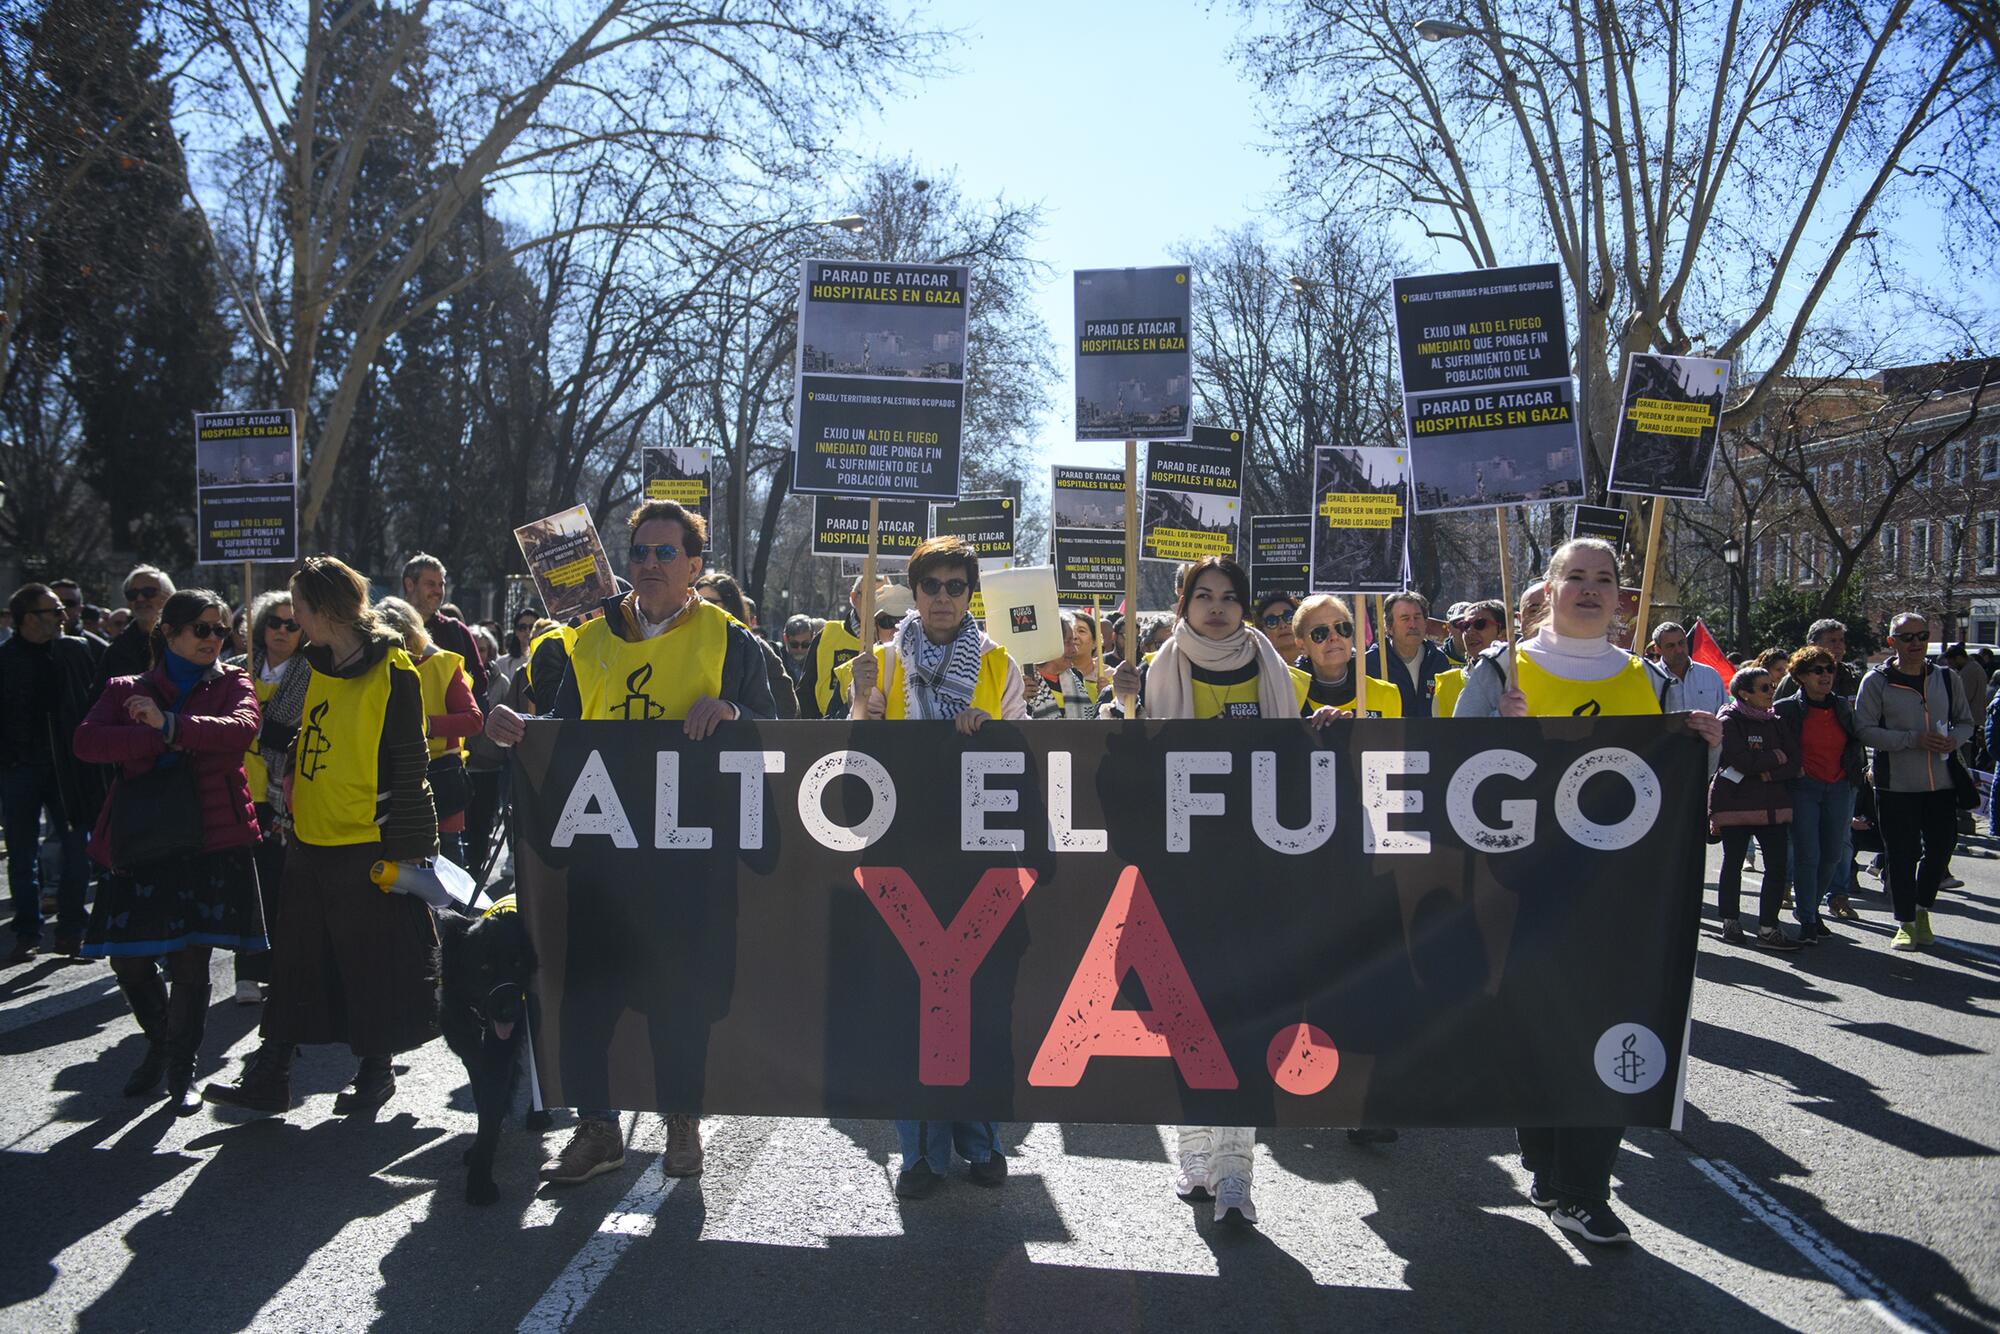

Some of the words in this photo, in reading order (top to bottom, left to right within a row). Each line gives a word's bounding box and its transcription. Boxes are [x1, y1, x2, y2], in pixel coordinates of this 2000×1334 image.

[822, 269, 868, 283] PARAD
[873, 272, 891, 284] DE
[896, 273, 949, 286] ATACAR
[813, 285, 897, 301] HOSPITALES
[902, 289, 920, 302] EN
[925, 290, 961, 304] GAZA
[1434, 288, 1478, 300] TERRITORIOS
[1478, 285, 1517, 297] PALESTINOS
[1518, 281, 1553, 293] OCUPADOS
[1088, 323, 1118, 336] PARAD
[1122, 323, 1134, 335] DE
[1138, 322, 1176, 334] ATACAR
[1424, 325, 1450, 339] EXIJO
[1453, 324, 1467, 336] UN
[1469, 322, 1493, 335] ALTO
[1495, 321, 1507, 332] EL
[1509, 317, 1542, 331] FUEGO
[1082, 339, 1140, 352] HOSPITALES
[1143, 338, 1156, 350] EN
[1159, 337, 1185, 350] GAZA
[1417, 340, 1471, 355] INMEDIATO
[1474, 338, 1493, 350] QUE
[1496, 333, 1529, 348] PONGA
[1531, 332, 1548, 343] FIN
[1431, 357, 1442, 369] AL
[1445, 350, 1511, 368] SUFRIMIENTO
[1514, 349, 1527, 361] DE
[1529, 348, 1541, 360] LA
[1445, 366, 1501, 383] POBLACIÓN
[1504, 364, 1530, 377] CIVIL
[840, 394, 882, 405] TERRITORIOS
[882, 396, 920, 406] PALESTINOS
[921, 398, 956, 408] OCUPADOS
[1422, 399, 1470, 416] PARAD
[1475, 397, 1494, 410] DE
[1499, 392, 1553, 408] ATACAR
[1661, 402, 1672, 410] LOS
[1674, 403, 1707, 413] HOSPITALES
[206, 418, 233, 427] PARAD
[248, 415, 281, 425] ATACAR
[1416, 413, 1503, 433] HOSPITALES
[1508, 410, 1526, 424] EN
[1531, 406, 1569, 422] GAZA
[1629, 410, 1637, 418] NO
[1638, 411, 1662, 420] PUEDEN
[253, 426, 265, 436] EN
[268, 426, 289, 435] GAZA
[823, 427, 849, 440] EXIJO
[852, 428, 865, 440] UN
[867, 430, 890, 442] ALTO
[893, 431, 904, 442] EL
[907, 431, 938, 444] FUEGO
[1661, 424, 1673, 432] LOS
[815, 442, 867, 456] INMEDIATO
[869, 444, 888, 457] QUE
[891, 446, 923, 459] PONGA
[925, 447, 942, 460] FIN
[825, 458, 837, 469] AL
[839, 458, 903, 472] SUFRIMIENTO
[906, 461, 918, 473] DE
[921, 462, 932, 474] LA
[1157, 460, 1184, 472] PARAD
[1187, 463, 1197, 473] DE
[1200, 464, 1230, 477] ATACAR
[838, 472, 891, 487] POBLACIÓN
[894, 475, 919, 488] CIVIL
[1061, 471, 1083, 479] PARAD
[1085, 472, 1093, 480] DE
[1095, 473, 1120, 481] ATACAR
[1151, 471, 1200, 486] HOSPITALES
[1203, 477, 1214, 486] EN
[1216, 478, 1237, 489] GAZA
[1057, 479, 1098, 489] HOSPITALES
[1100, 481, 1108, 489] EN
[1110, 482, 1126, 490] GAZA
[826, 518, 858, 530] PARAD
[878, 520, 915, 532] ATACAR
[820, 532, 878, 545] HOSPITAL
[882, 535, 894, 546] EN
[898, 535, 923, 547] GAZA
[967, 533, 977, 541] DE
[978, 531, 1004, 541] ATACAR
[1157, 539, 1180, 547] PUEDEN
[1190, 531, 1224, 541] HOSPITALES
[982, 543, 991, 551] EN
[992, 542, 1011, 551] GAZA
[1181, 549, 1191, 558] LOS
[1104, 581, 1116, 589] CIVIL
[550, 749, 897, 851] ALTO
[961, 751, 1107, 852] EL
[1165, 746, 1662, 855] FUEGO
[853, 864, 1339, 1095] YA.
